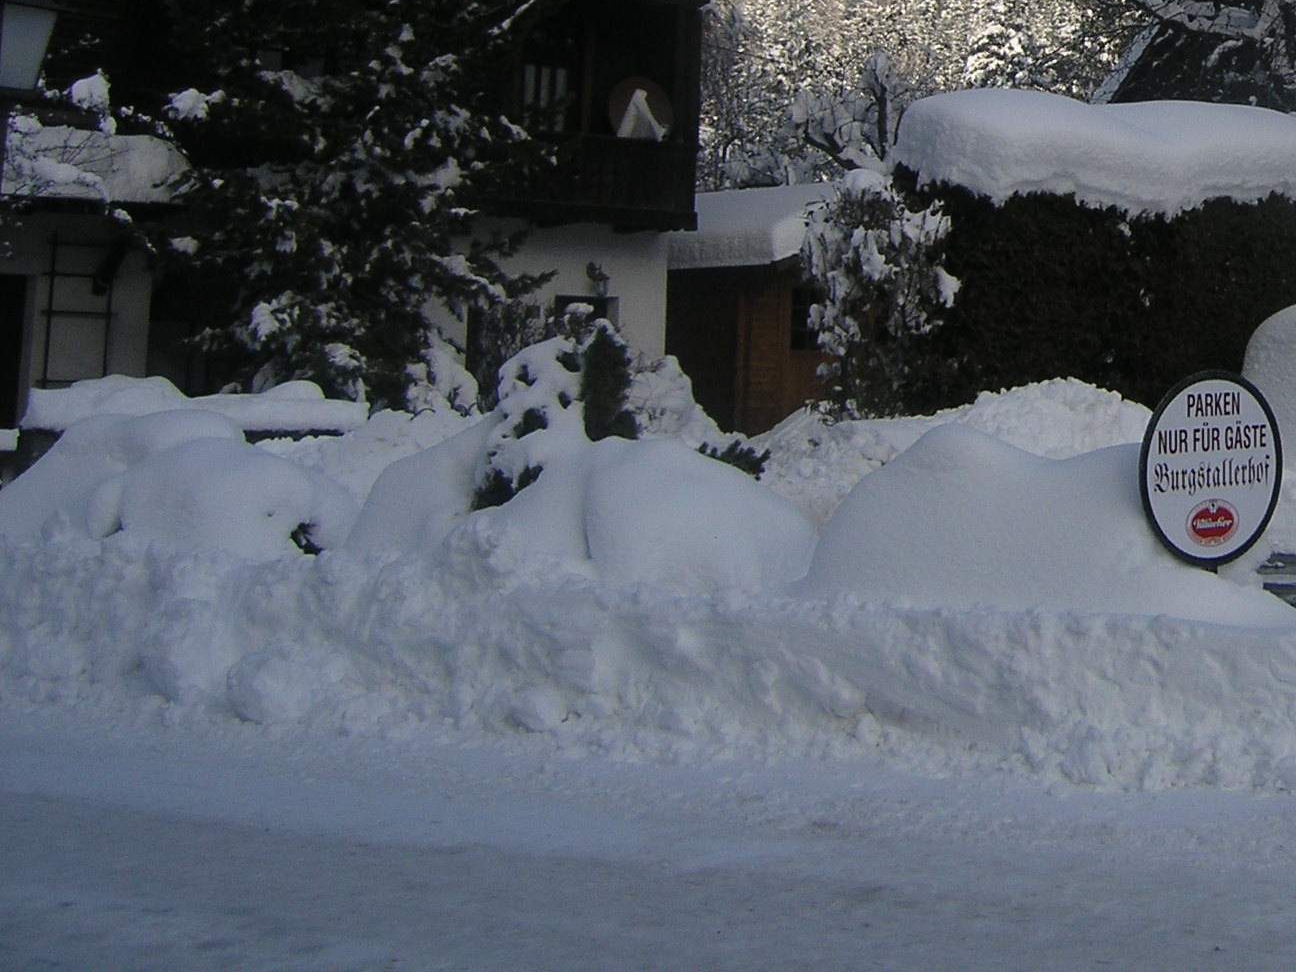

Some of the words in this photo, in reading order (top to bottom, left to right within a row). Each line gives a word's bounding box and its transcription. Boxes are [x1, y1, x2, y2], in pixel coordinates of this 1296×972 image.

[1187, 392, 1240, 417] PARKEN
[1158, 429, 1188, 454] NUR
[1193, 422, 1220, 452] FÜR
[1225, 420, 1267, 450] GÄSTE
[1154, 455, 1270, 496] Burgstallerhof
